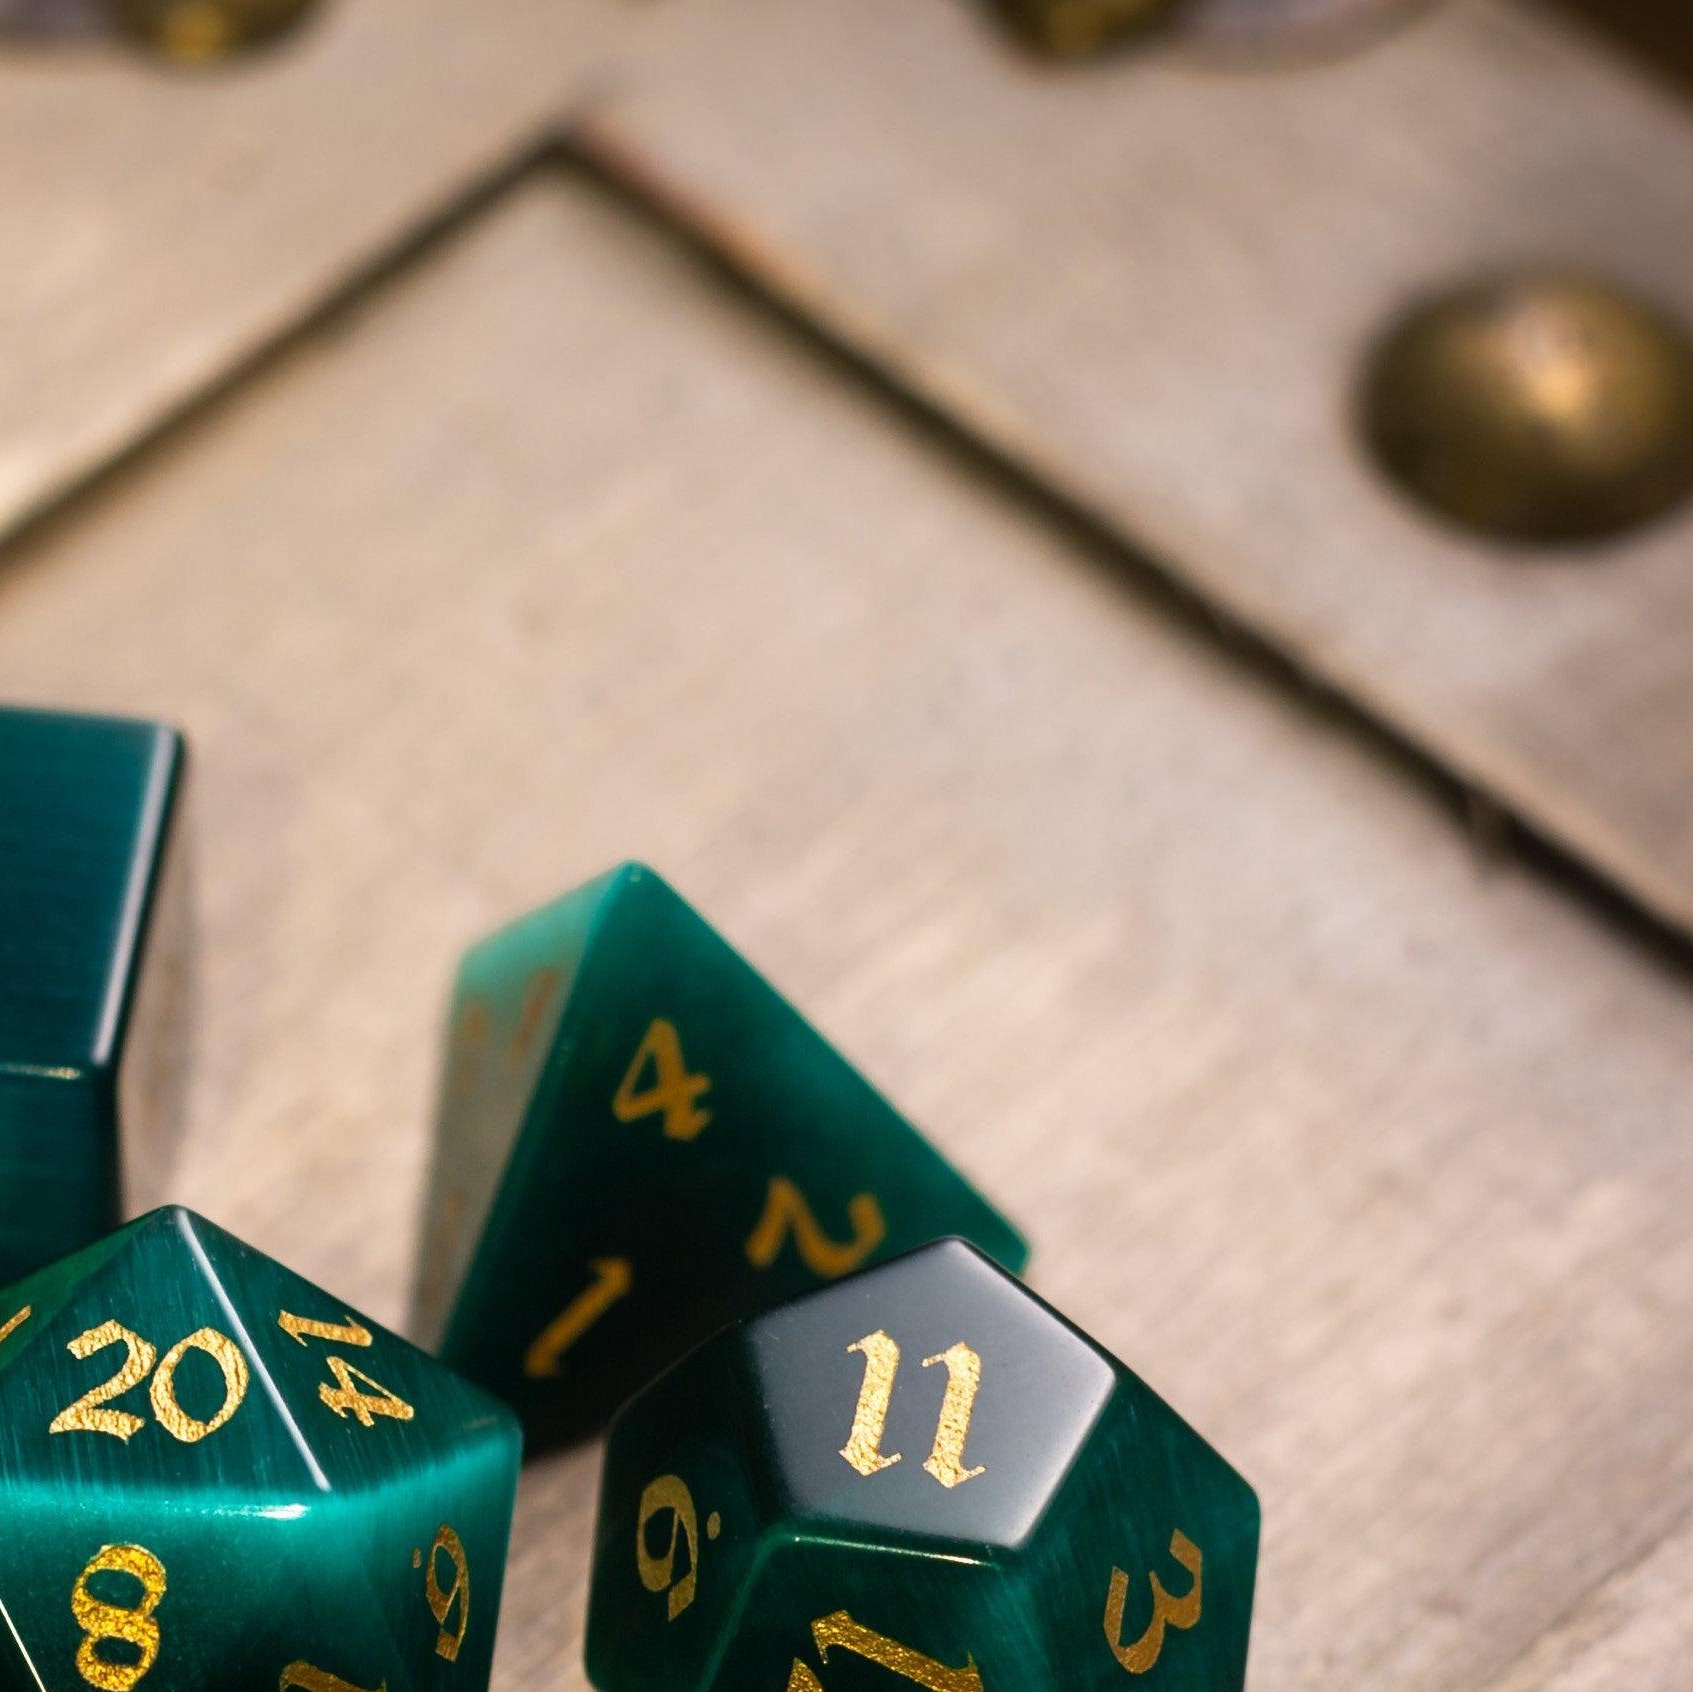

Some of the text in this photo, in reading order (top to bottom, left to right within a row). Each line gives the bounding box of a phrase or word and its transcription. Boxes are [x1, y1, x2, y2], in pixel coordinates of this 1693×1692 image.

[613, 1020, 709, 1139] 4
[747, 1179, 884, 1276] 2
[278, 1309, 414, 1428] 14
[528, 1259, 629, 1375] 1
[50, 1320, 249, 1444] 20
[841, 1330, 985, 1488] 11
[72, 1546, 166, 1692] 8
[1103, 1531, 1202, 1674] 3
